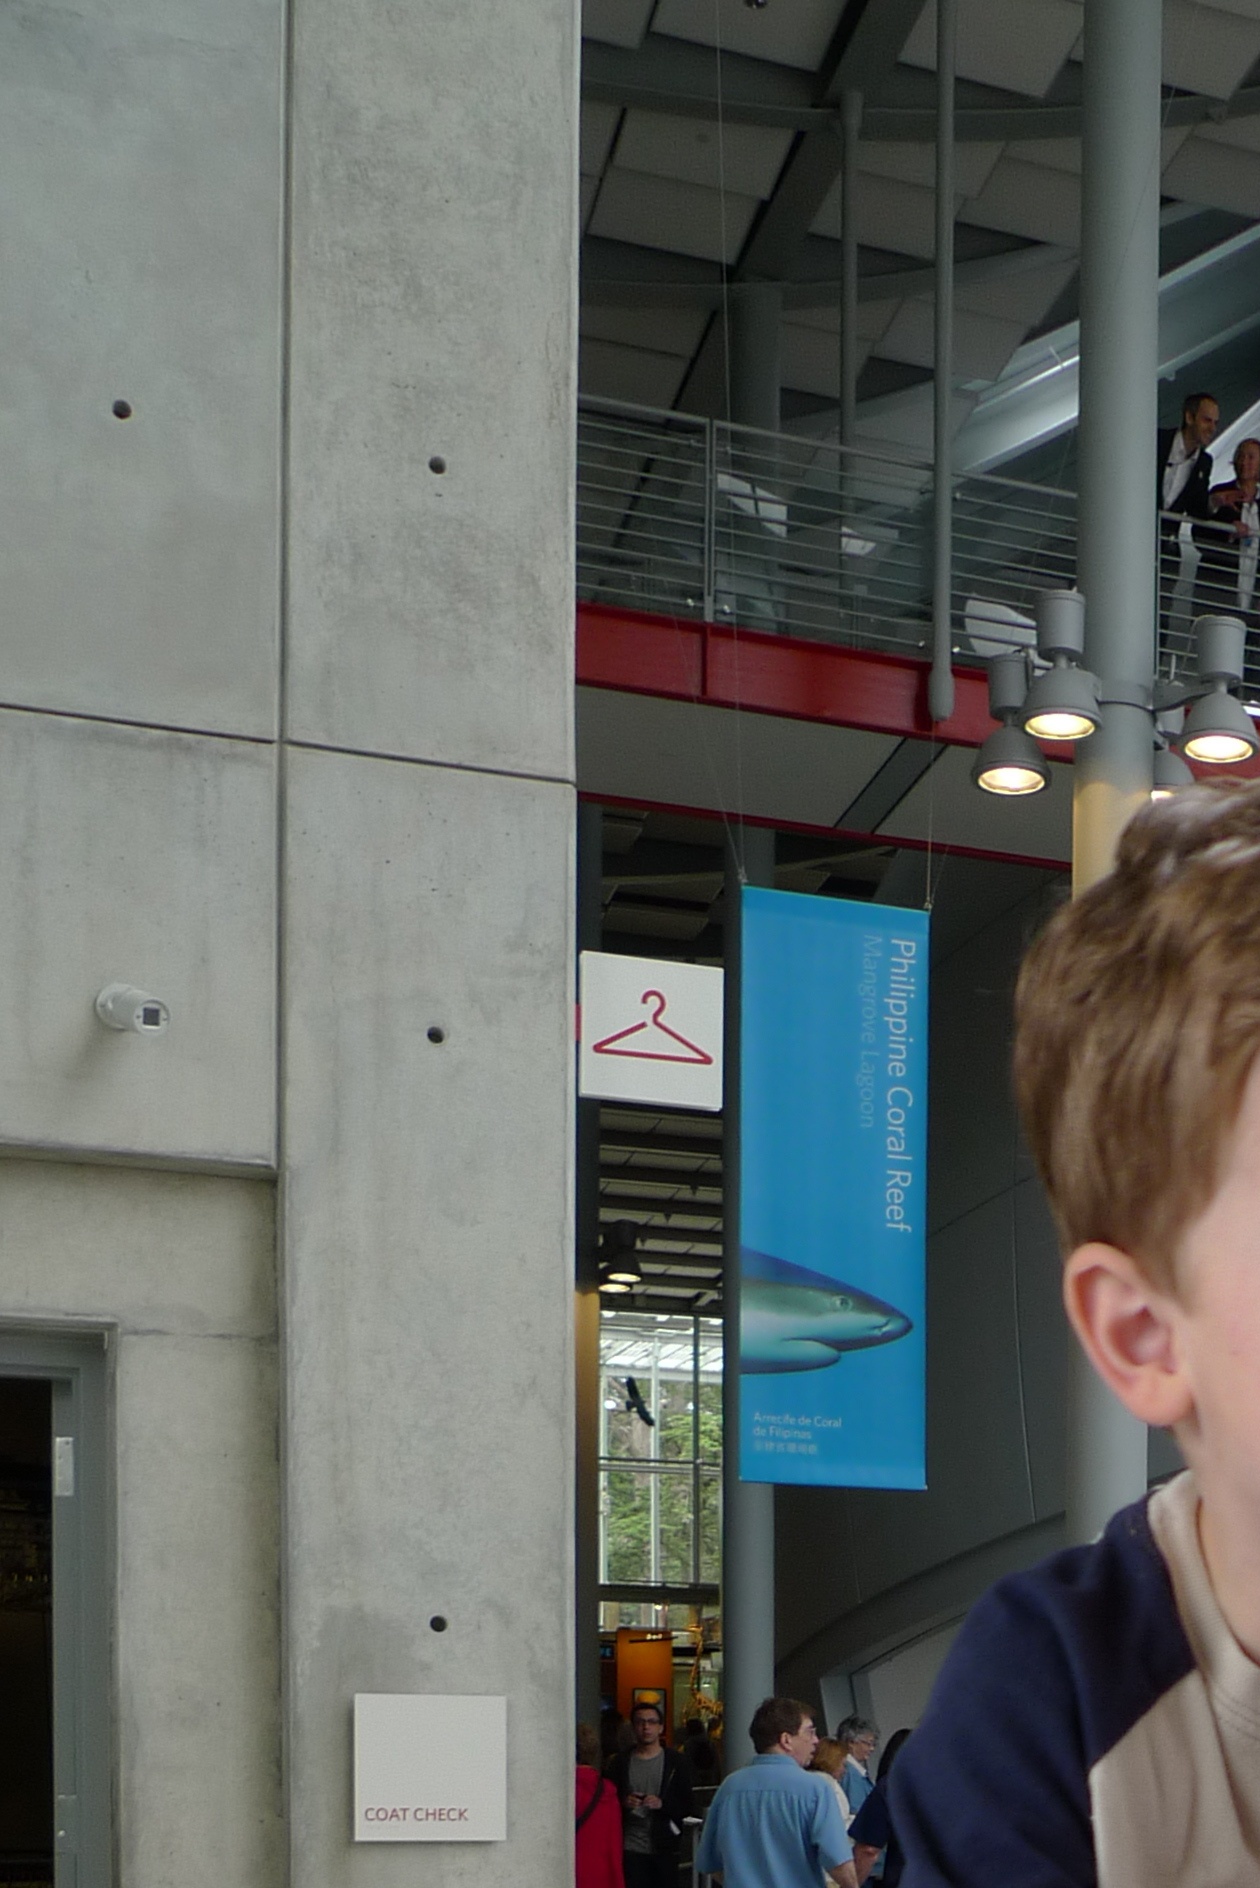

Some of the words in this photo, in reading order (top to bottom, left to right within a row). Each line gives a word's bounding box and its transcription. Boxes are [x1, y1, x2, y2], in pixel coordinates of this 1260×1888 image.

[859, 934, 883, 1043] Mangrove
[884, 938, 916, 1077] Philippine
[856, 1050, 880, 1128] Lagoon
[887, 1087, 914, 1160] Coral
[886, 1170, 912, 1233] Reef
[754, 1412, 795, 1425] Arrecife
[798, 1415, 811, 1426] de
[814, 1416, 842, 1427] Coral
[754, 1426, 766, 1436] de
[769, 1426, 811, 1439] Filipinas
[364, 1807, 410, 1821] COAT
[413, 1807, 469, 1822] CHECK
